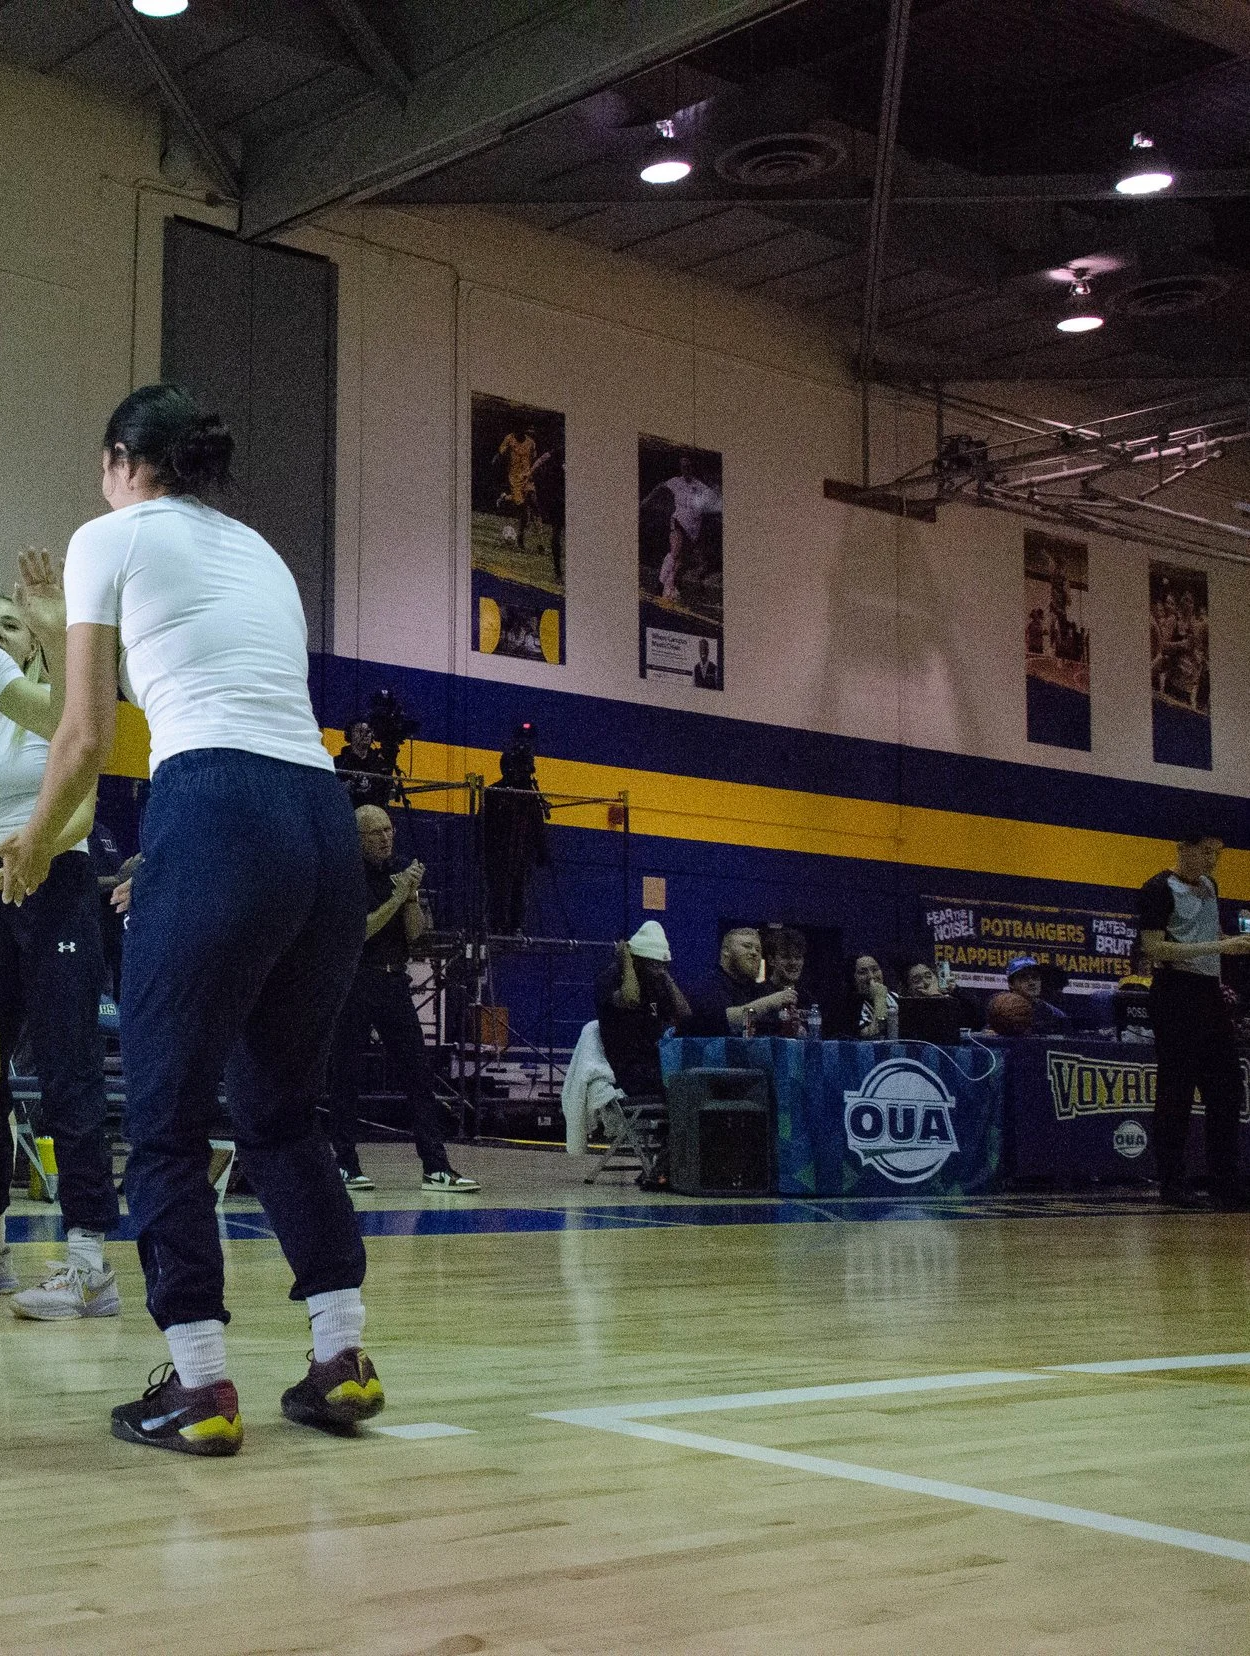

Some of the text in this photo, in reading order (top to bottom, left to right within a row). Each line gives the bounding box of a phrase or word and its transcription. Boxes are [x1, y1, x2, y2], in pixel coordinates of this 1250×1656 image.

[981, 917, 1085, 943] POTBANGERS
[1095, 934, 1133, 957] BRUIT
[1055, 953, 1132, 976] MARMITES
[850, 1104, 953, 1142] OUA
[1115, 1134, 1146, 1146] OUA
